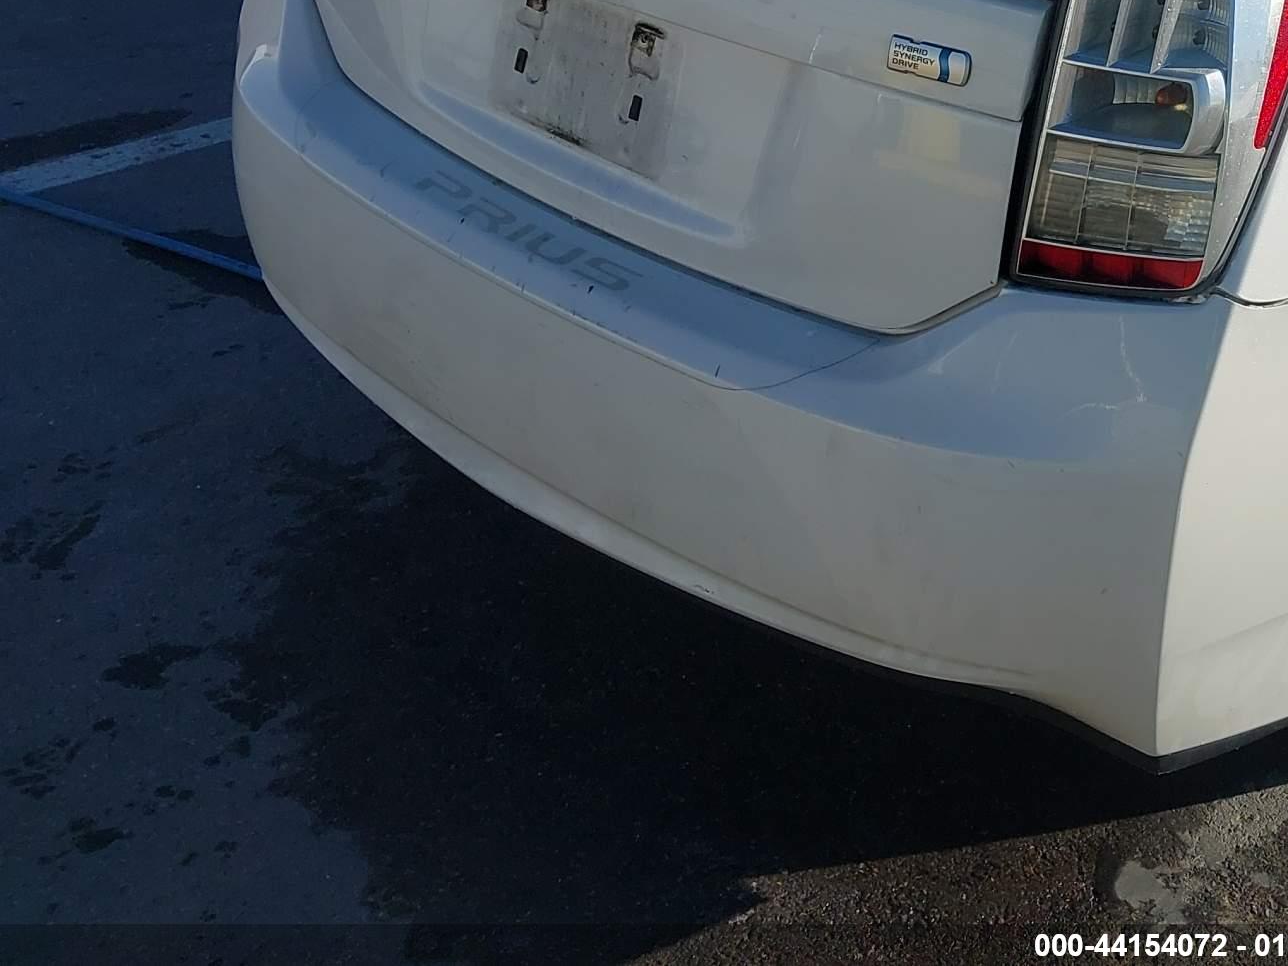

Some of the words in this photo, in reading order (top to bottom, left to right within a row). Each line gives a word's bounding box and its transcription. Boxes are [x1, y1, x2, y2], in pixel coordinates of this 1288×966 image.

[893, 41, 929, 57] HYBRID
[891, 57, 920, 71] DRIVE
[892, 49, 936, 67] SYNERGY
[414, 168, 645, 292] PRIUS
